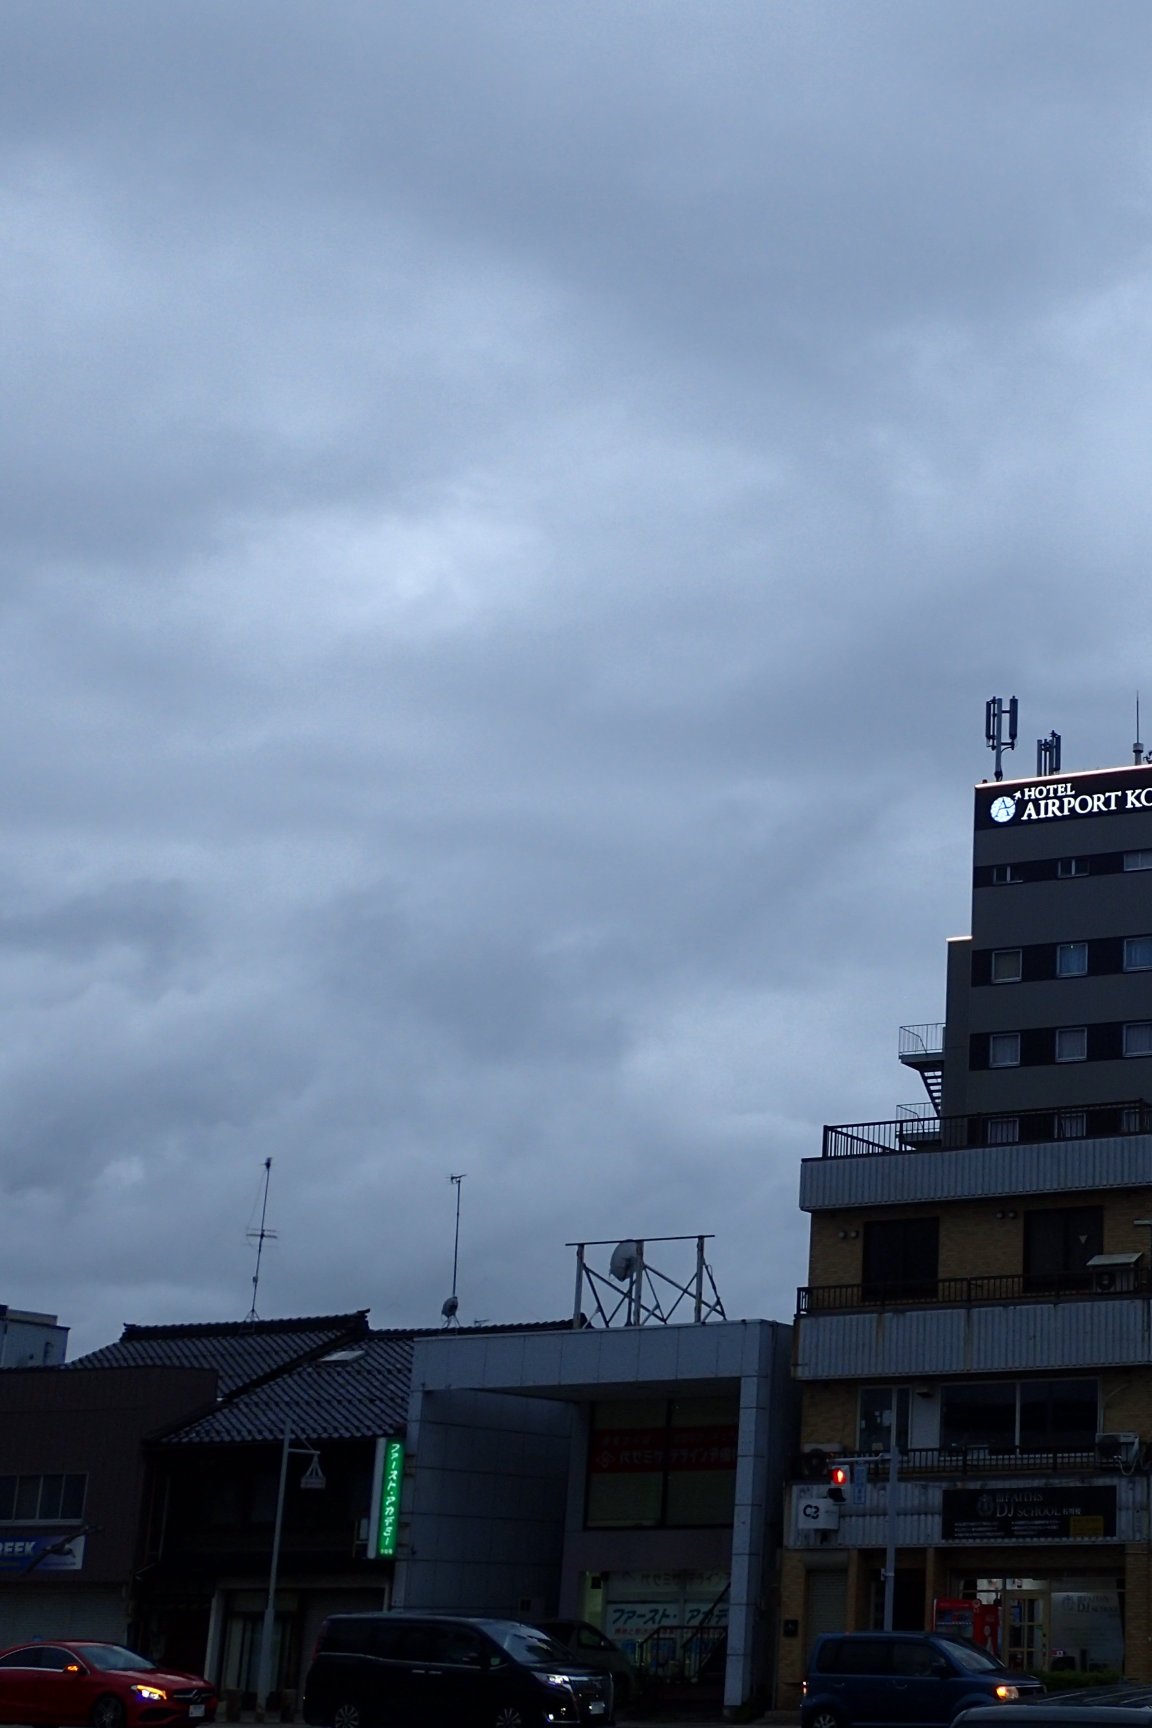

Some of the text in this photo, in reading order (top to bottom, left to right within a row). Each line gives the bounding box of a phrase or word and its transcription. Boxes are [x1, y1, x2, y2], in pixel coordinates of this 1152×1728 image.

[1024, 783, 1075, 800] HOTEL
[1021, 791, 1121, 820] AIRPORT
[996, 1502, 1014, 1517] DJ
